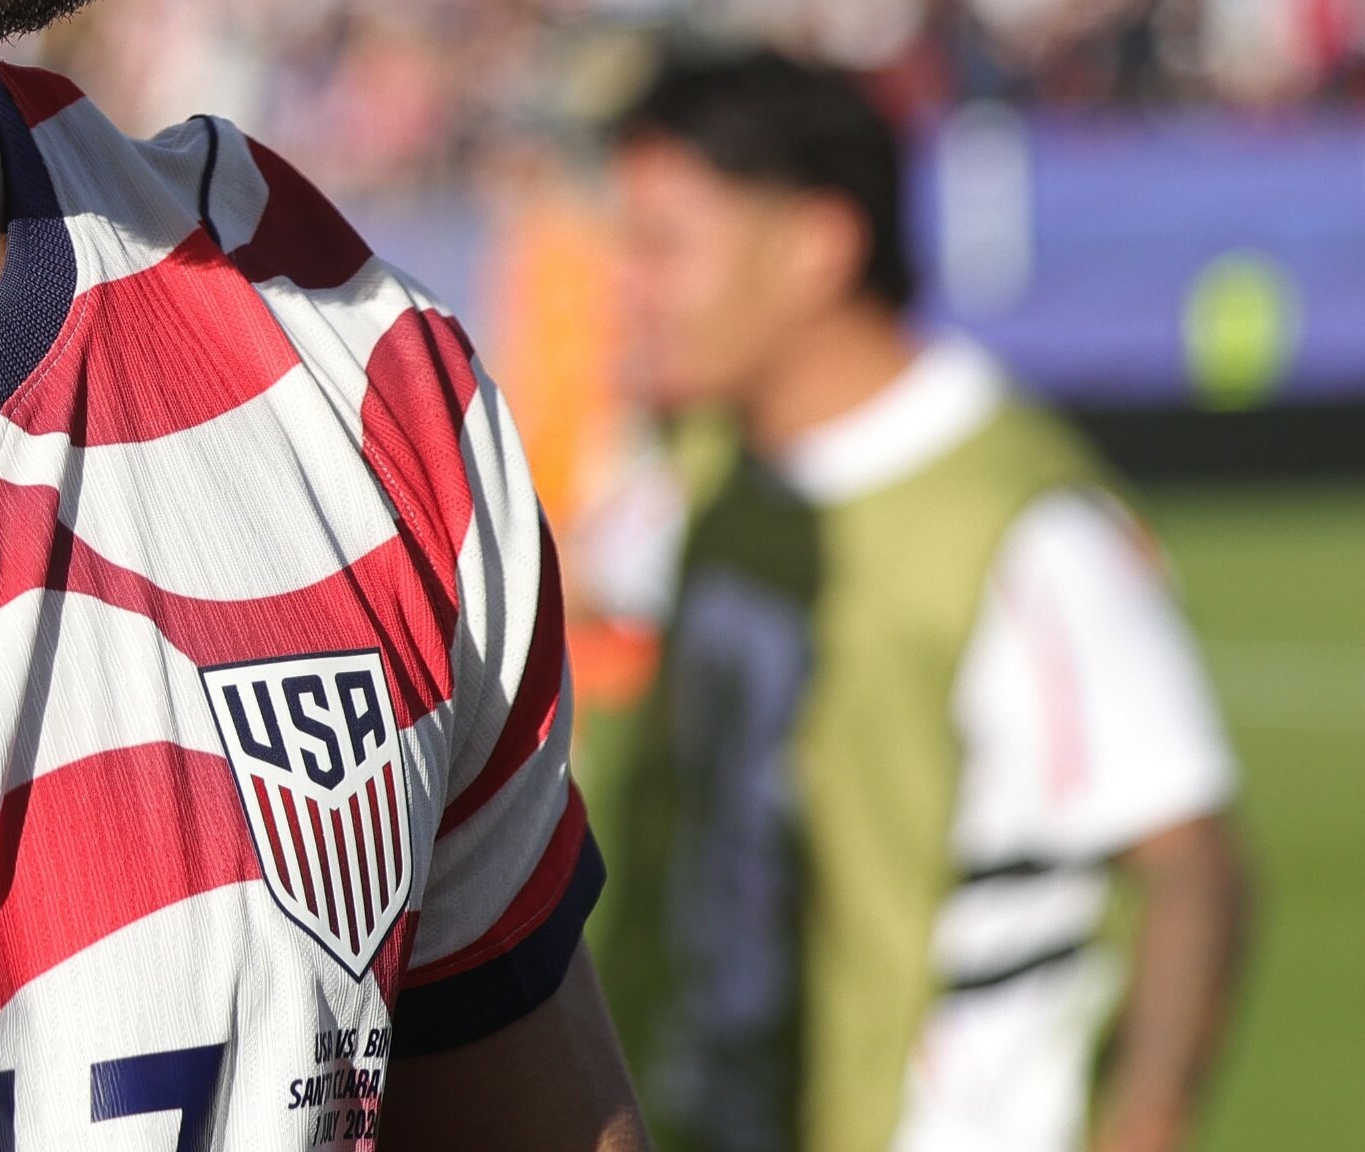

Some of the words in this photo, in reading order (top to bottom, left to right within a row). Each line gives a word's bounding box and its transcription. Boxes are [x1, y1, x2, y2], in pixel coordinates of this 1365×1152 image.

[222, 670, 387, 791] USA
[315, 1029, 333, 1064] USA
[287, 1072, 333, 1110] SANT
[343, 1108, 376, 1140] 202
